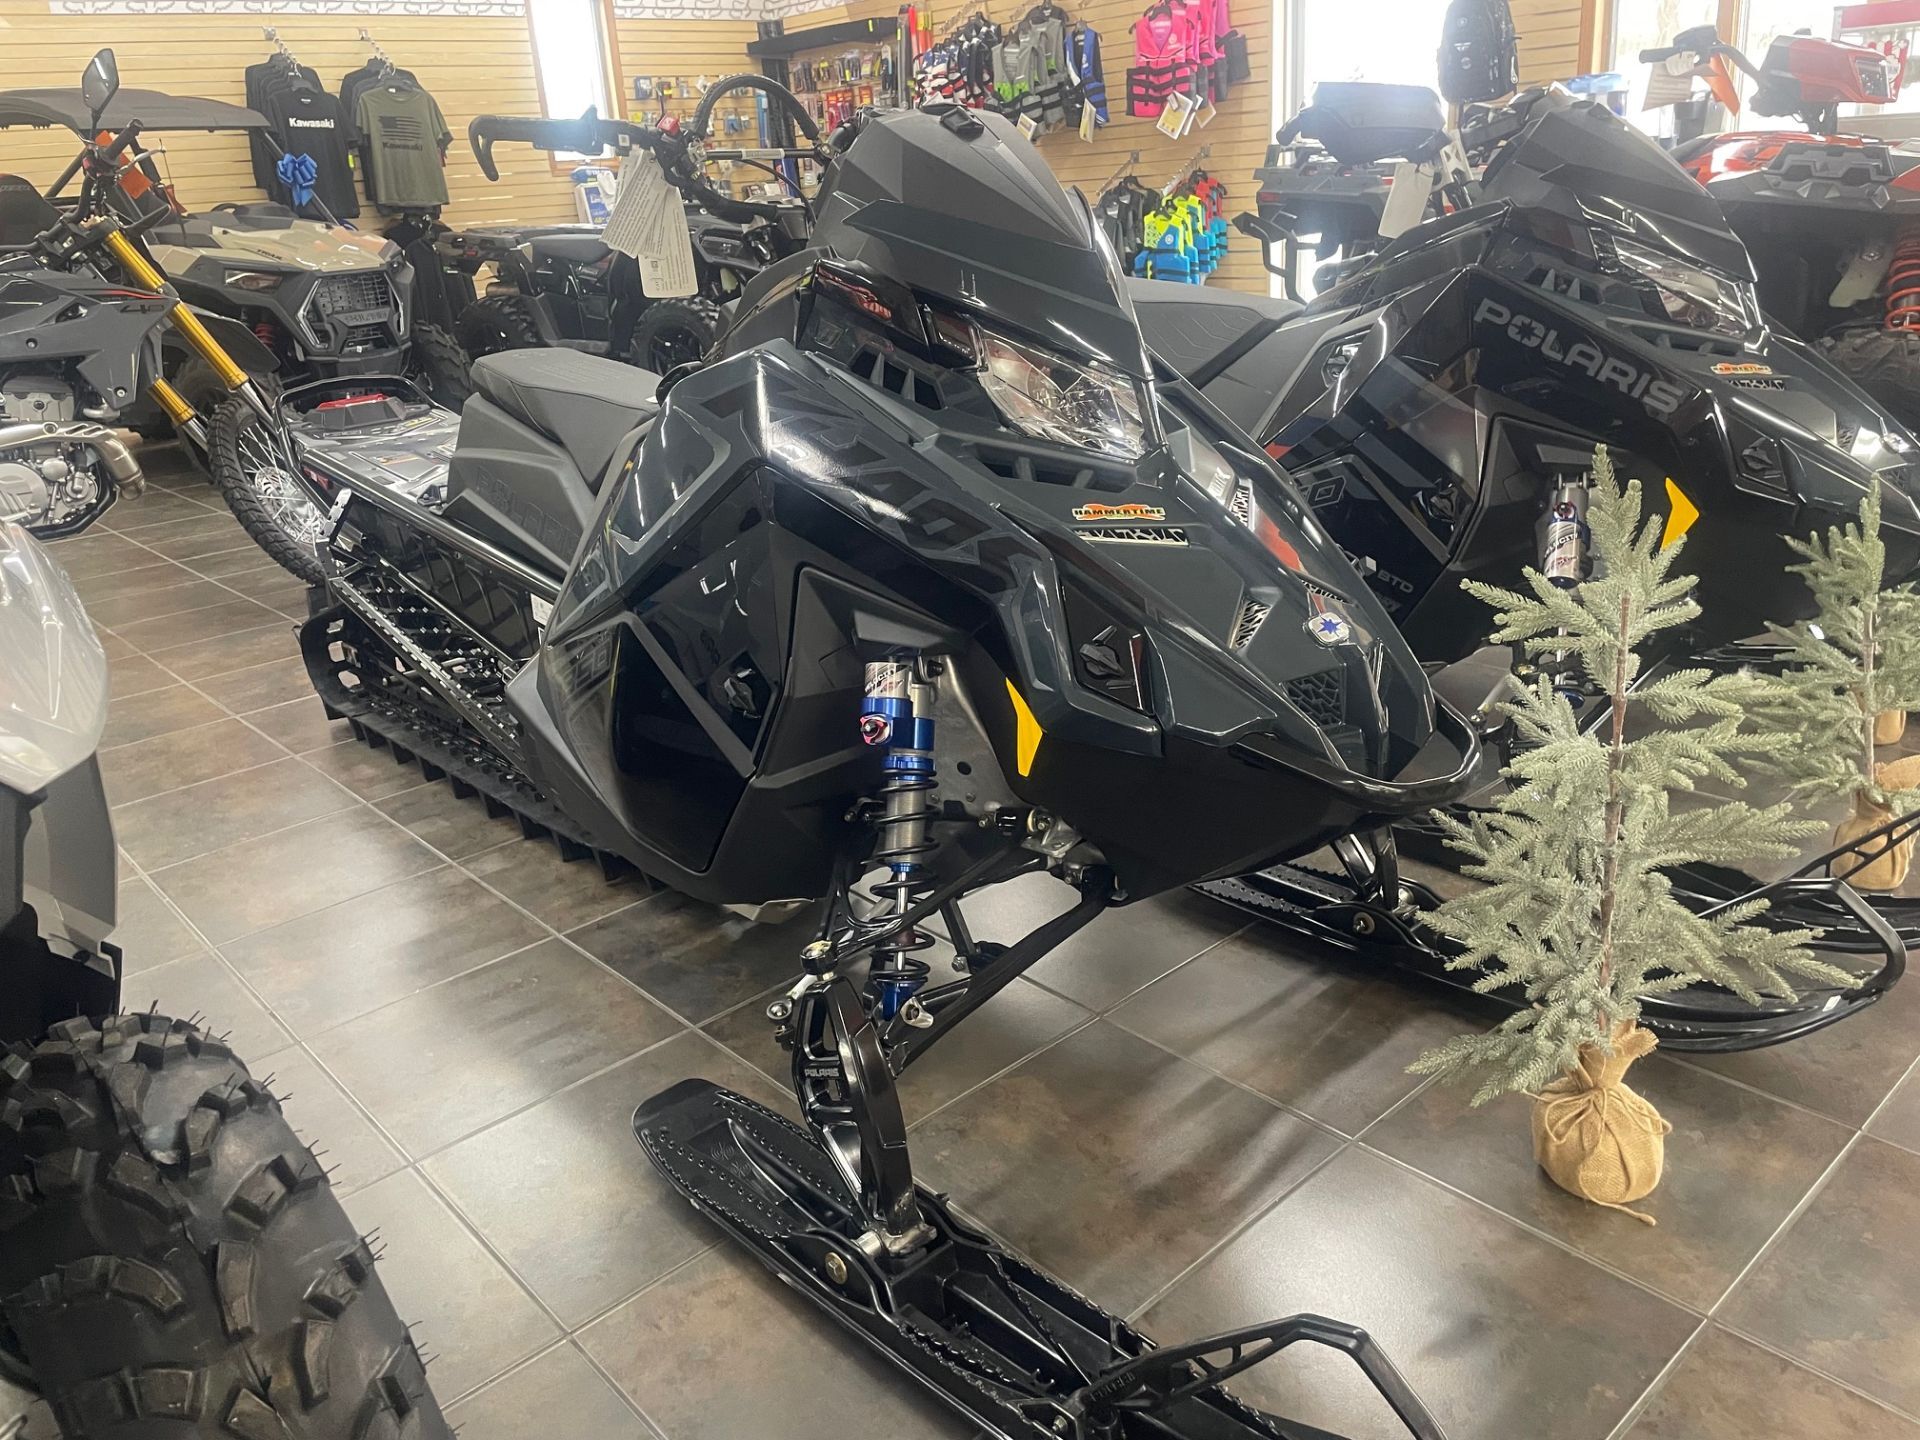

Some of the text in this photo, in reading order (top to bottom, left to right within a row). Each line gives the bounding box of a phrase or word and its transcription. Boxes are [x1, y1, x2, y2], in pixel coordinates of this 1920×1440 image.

[289, 117, 335, 129] Kawasaki
[382, 141, 423, 151] Kawasaki
[1473, 298, 1687, 414] POLARIS
[1073, 508, 1165, 516] HAMMERTIME
[804, 1067, 840, 1078] POLARIS
